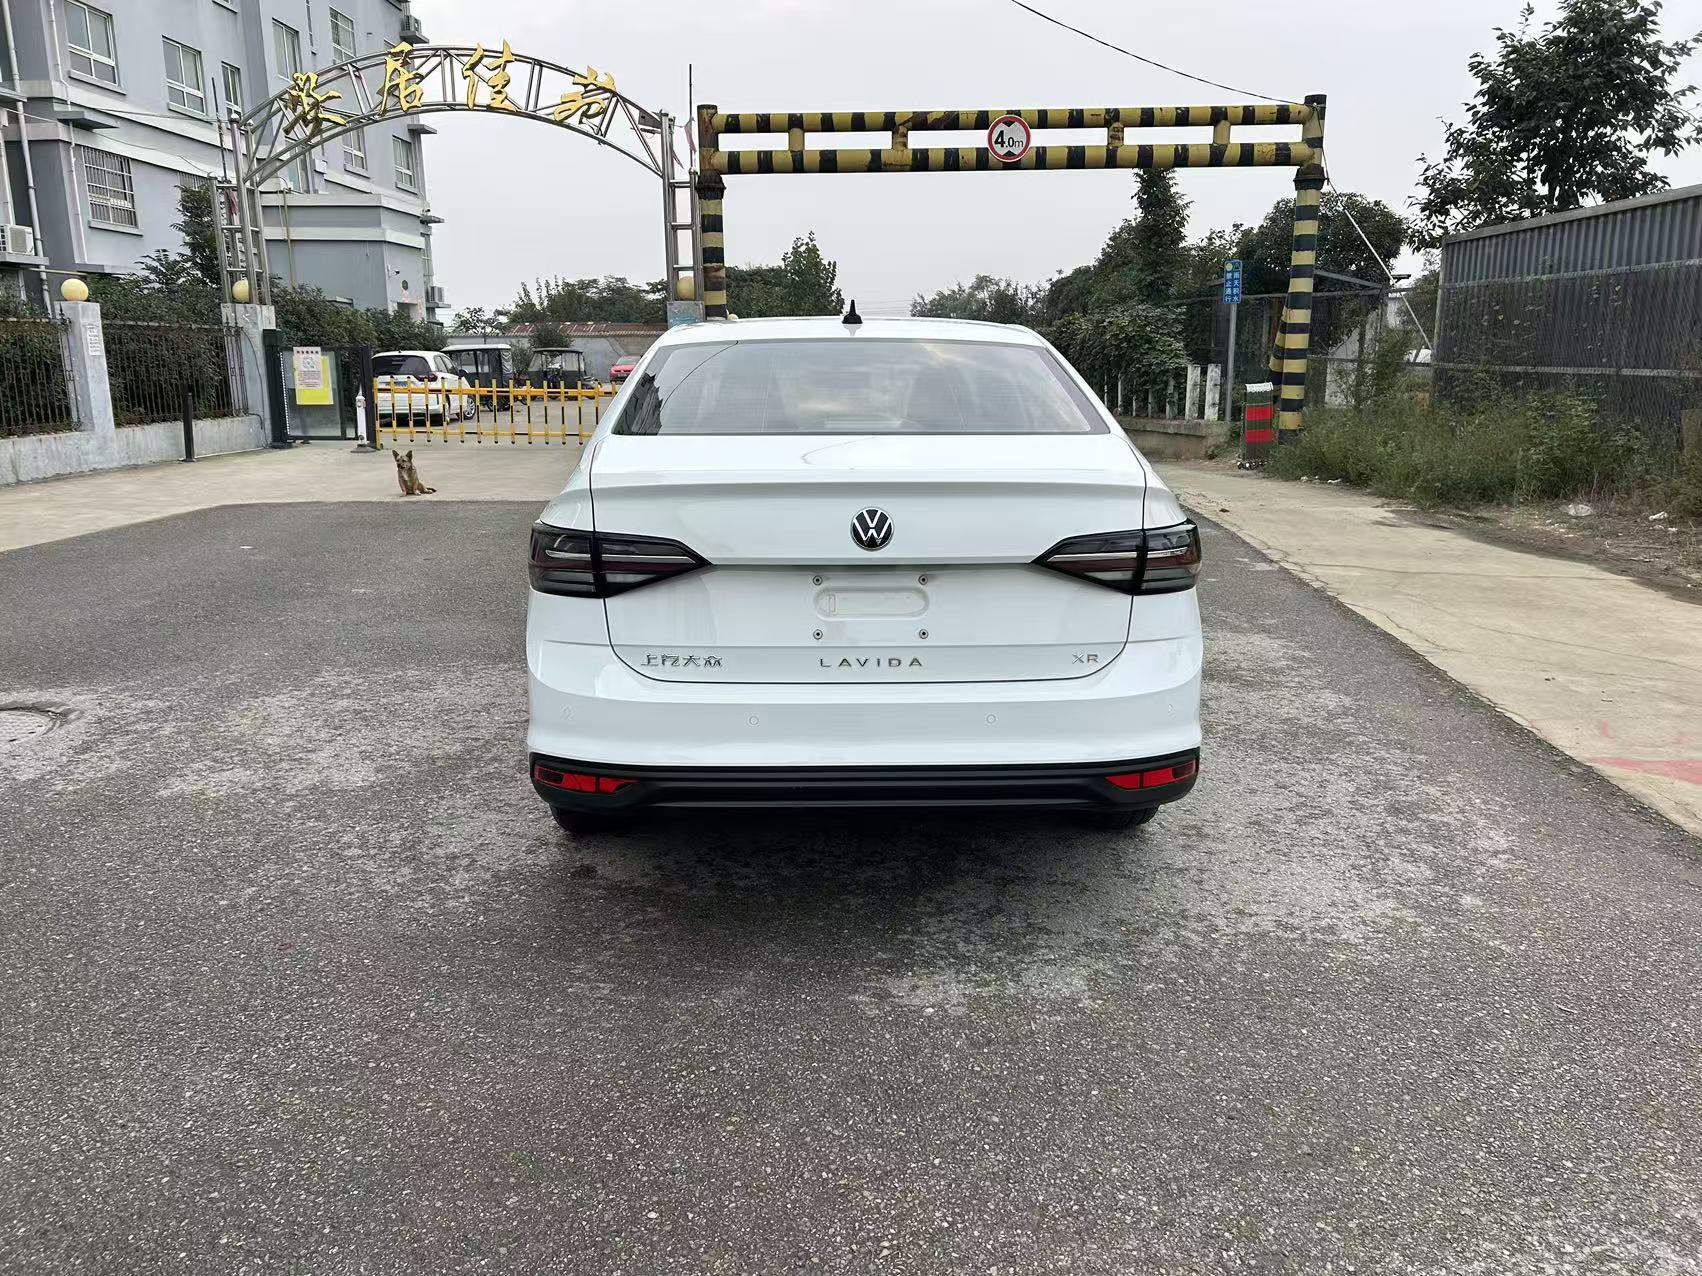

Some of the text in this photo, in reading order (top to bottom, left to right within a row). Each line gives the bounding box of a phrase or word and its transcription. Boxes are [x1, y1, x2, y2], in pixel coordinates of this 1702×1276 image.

[994, 130, 1024, 148] 4.0m
[640, 653, 723, 668] 上汽大众
[819, 658, 923, 668] LAVIDA
[1071, 653, 1099, 664] XR
